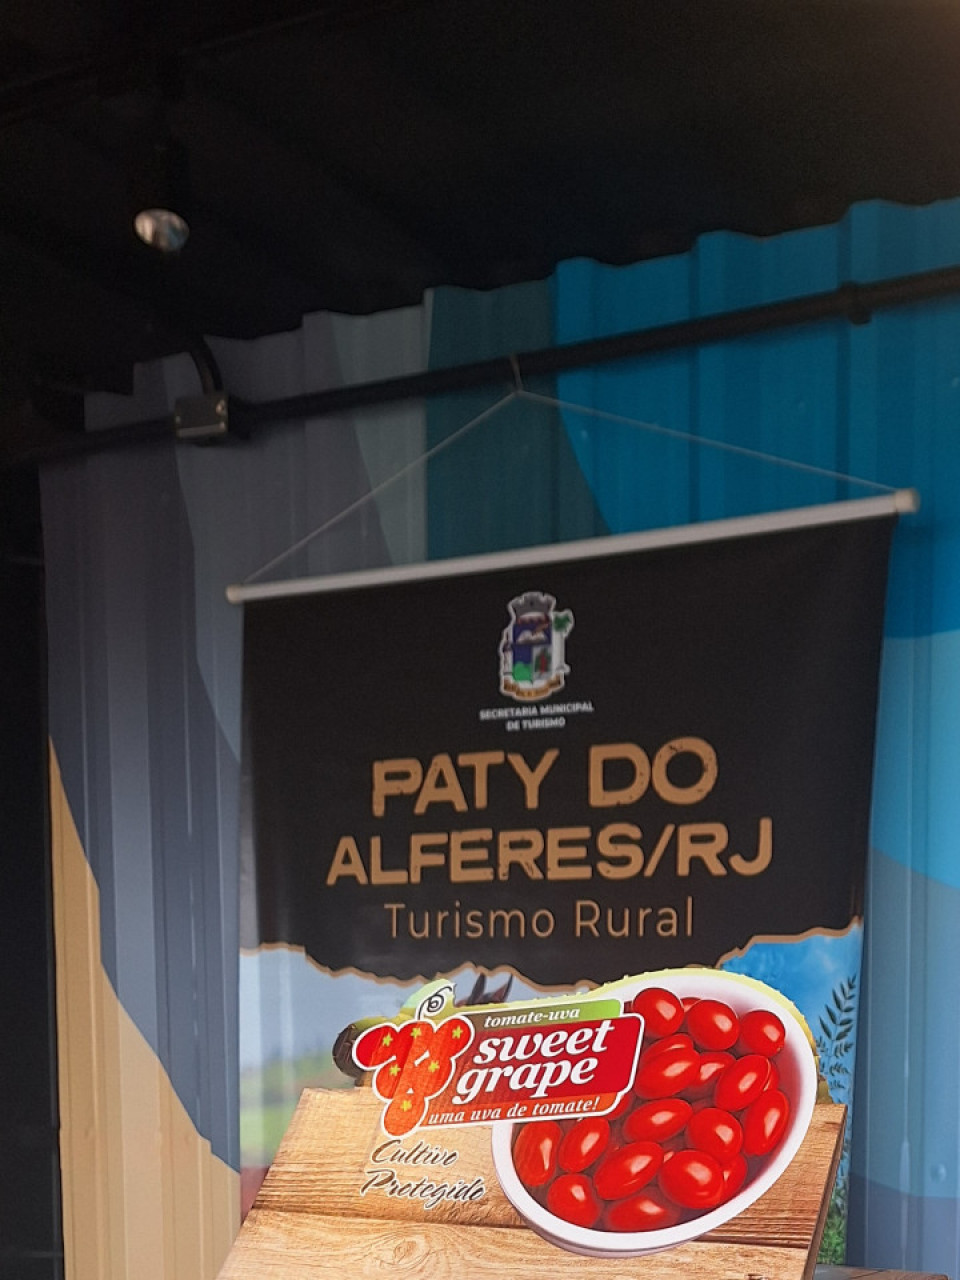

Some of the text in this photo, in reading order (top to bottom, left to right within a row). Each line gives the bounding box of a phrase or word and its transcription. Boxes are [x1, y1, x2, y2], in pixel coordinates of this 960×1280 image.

[479, 700, 594, 721] SECRETARIA MUNICIPAL
[506, 716, 566, 732] DE TURISMO
[371, 735, 718, 817] PATY DO
[325, 816, 774, 886] ALFERES/RJ
[384, 896, 694, 940] Turismo Rural
[483, 1007, 581, 1029] tomate-uva
[472, 1019, 615, 1065] sweet
[451, 1056, 599, 1105] grape
[428, 1096, 601, 1125] uma uva de tomate!
[371, 1139, 458, 1166] Cultivo
[360, 1168, 485, 1209] Protegido
